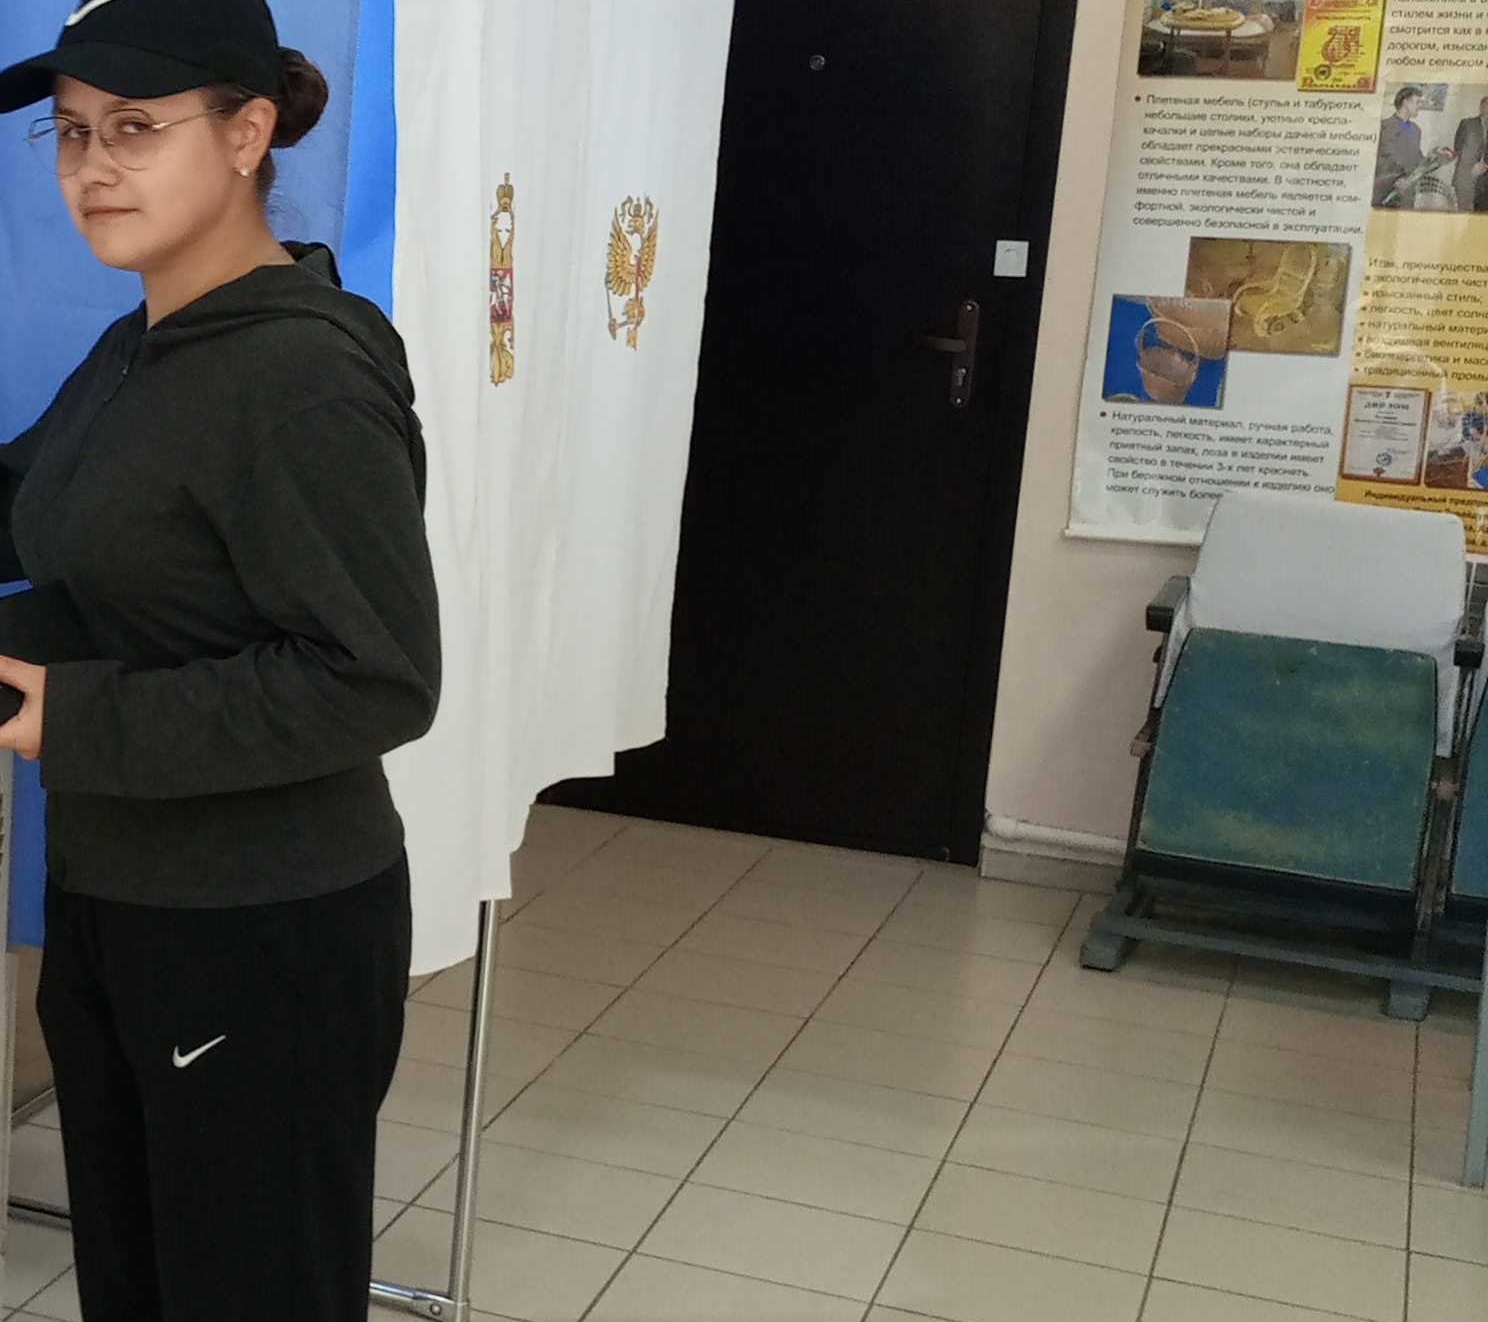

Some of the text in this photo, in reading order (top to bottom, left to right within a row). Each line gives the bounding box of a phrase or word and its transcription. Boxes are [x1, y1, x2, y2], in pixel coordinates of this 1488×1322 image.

[1391, 9, 1484, 20] стилем жизни и
[1389, 25, 1472, 36] смотрится как
[1386, 55, 1484, 68] любом сельском
[1203, 95, 1245, 107] мебель
[1293, 99, 1301, 108] и
[1144, 109, 1208, 121] небольшие
[1260, 115, 1305, 126] уютные
[1143, 126, 1187, 136] качалки
[1189, 128, 1197, 136] и
[1199, 128, 1236, 138] целые
[1238, 127, 1282, 139] наборы
[1284, 129, 1327, 140] дачной
[1140, 139, 1194, 151] обладает
[1196, 142, 1272, 155] прекрасными
[1210, 157, 1247, 169] Кроме
[1279, 161, 1301, 170] она
[1303, 160, 1360, 173] обладает
[1137, 171, 1200, 182] отличными
[1274, 174, 1283, 185] В
[1136, 186, 1178, 196] именно
[1235, 188, 1278, 200] мебель
[1281, 191, 1333, 203] является
[1189, 203, 1265, 214] экологически
[1266, 206, 1306, 216] чистой
[1308, 208, 1317, 217] и
[1133, 216, 1202, 228] совершенно
[1204, 217, 1270, 230] безопасной
[1272, 223, 1279, 231] в
[1373, 274, 1459, 286] экологическая
[1112, 411, 1187, 425] Натуральный
[1248, 422, 1289, 432] ручная
[1218, 435, 1254, 444] имеет
[1109, 441, 1163, 452] приятный
[1201, 448, 1228, 458] лоза
[1107, 455, 1158, 466] свойство
[1160, 458, 1167, 467] в
[1236, 464, 1256, 473] лет
[1107, 467, 1129, 479] При
[1105, 484, 1140, 494] может
